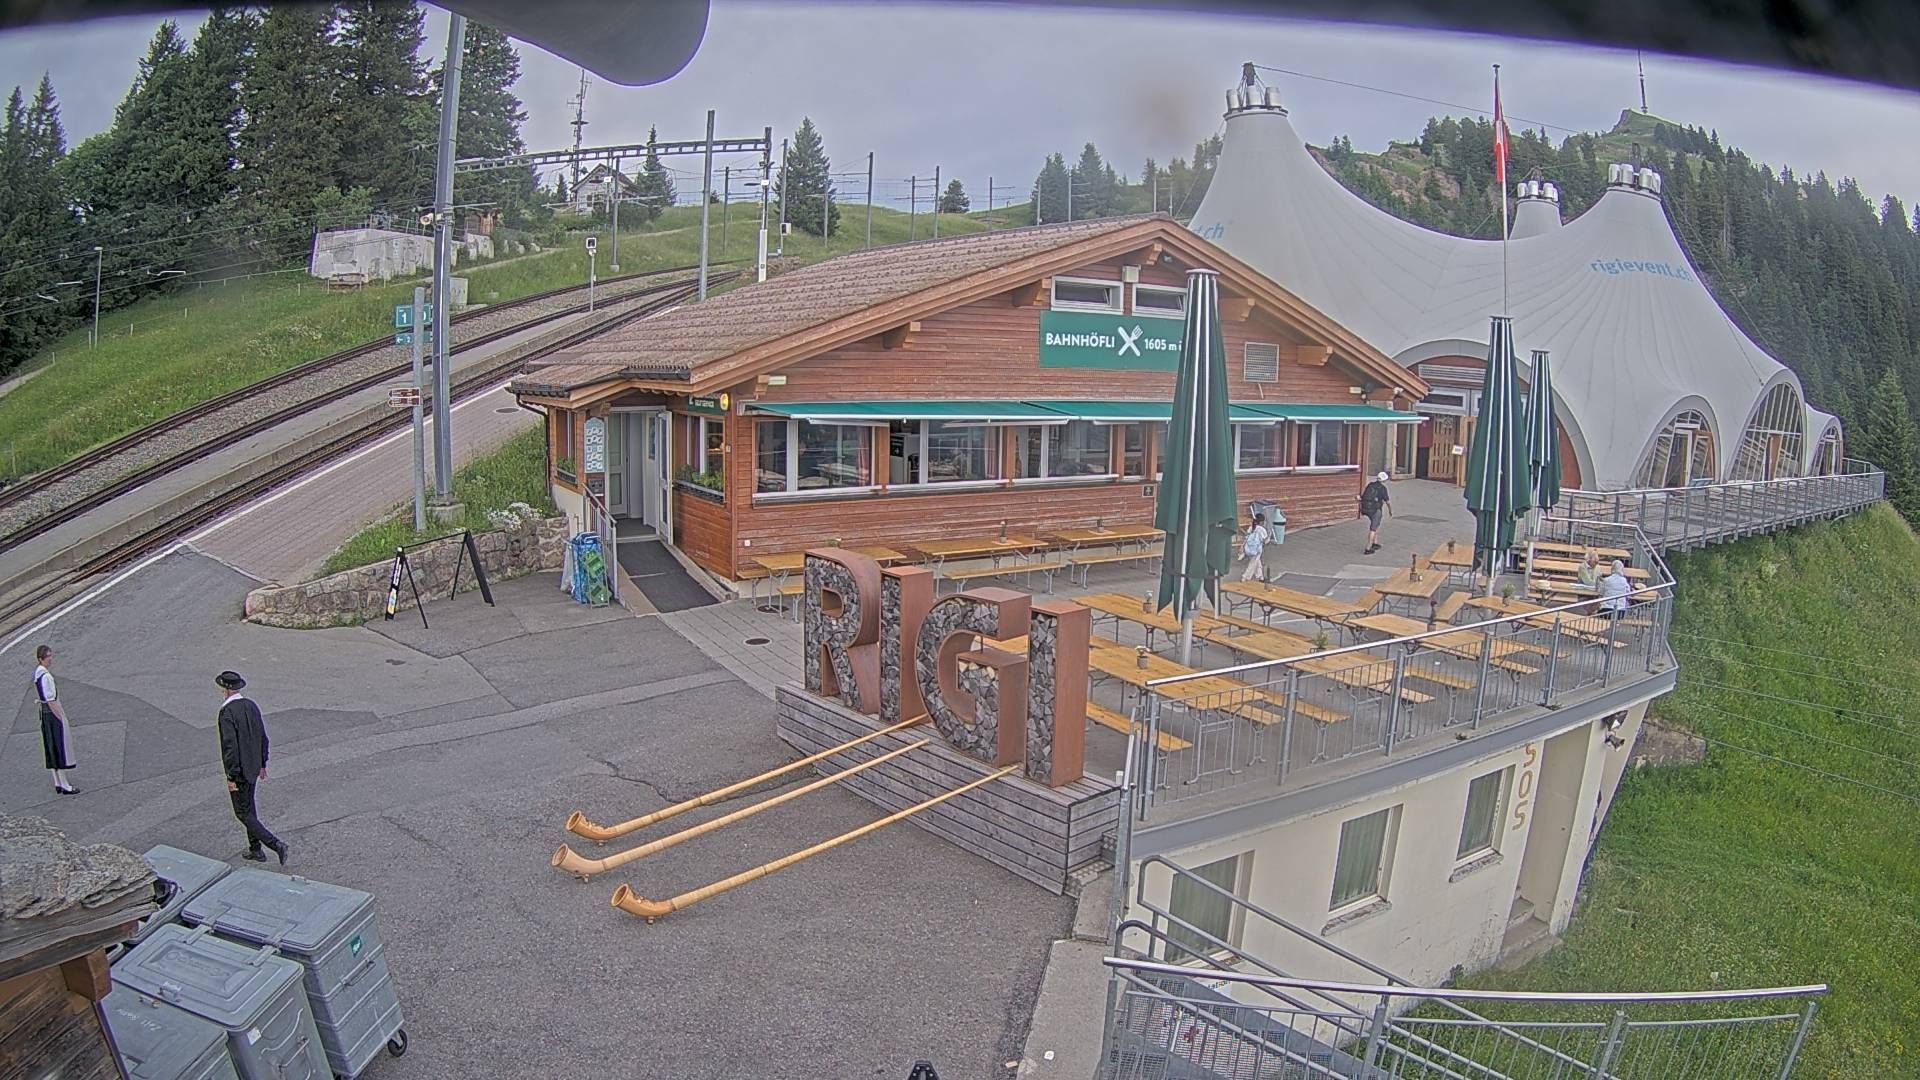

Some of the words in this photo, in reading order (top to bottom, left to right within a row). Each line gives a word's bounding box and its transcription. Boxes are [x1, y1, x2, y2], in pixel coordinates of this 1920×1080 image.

[401, 312, 407, 324] 1
[1045, 332, 1115, 348] BAHNHÖFLI
[1144, 337, 1167, 351] 1605
[1168, 343, 1178, 351] m
[804, 548, 1090, 788] RIGI
[1512, 741, 1537, 831] SOS
